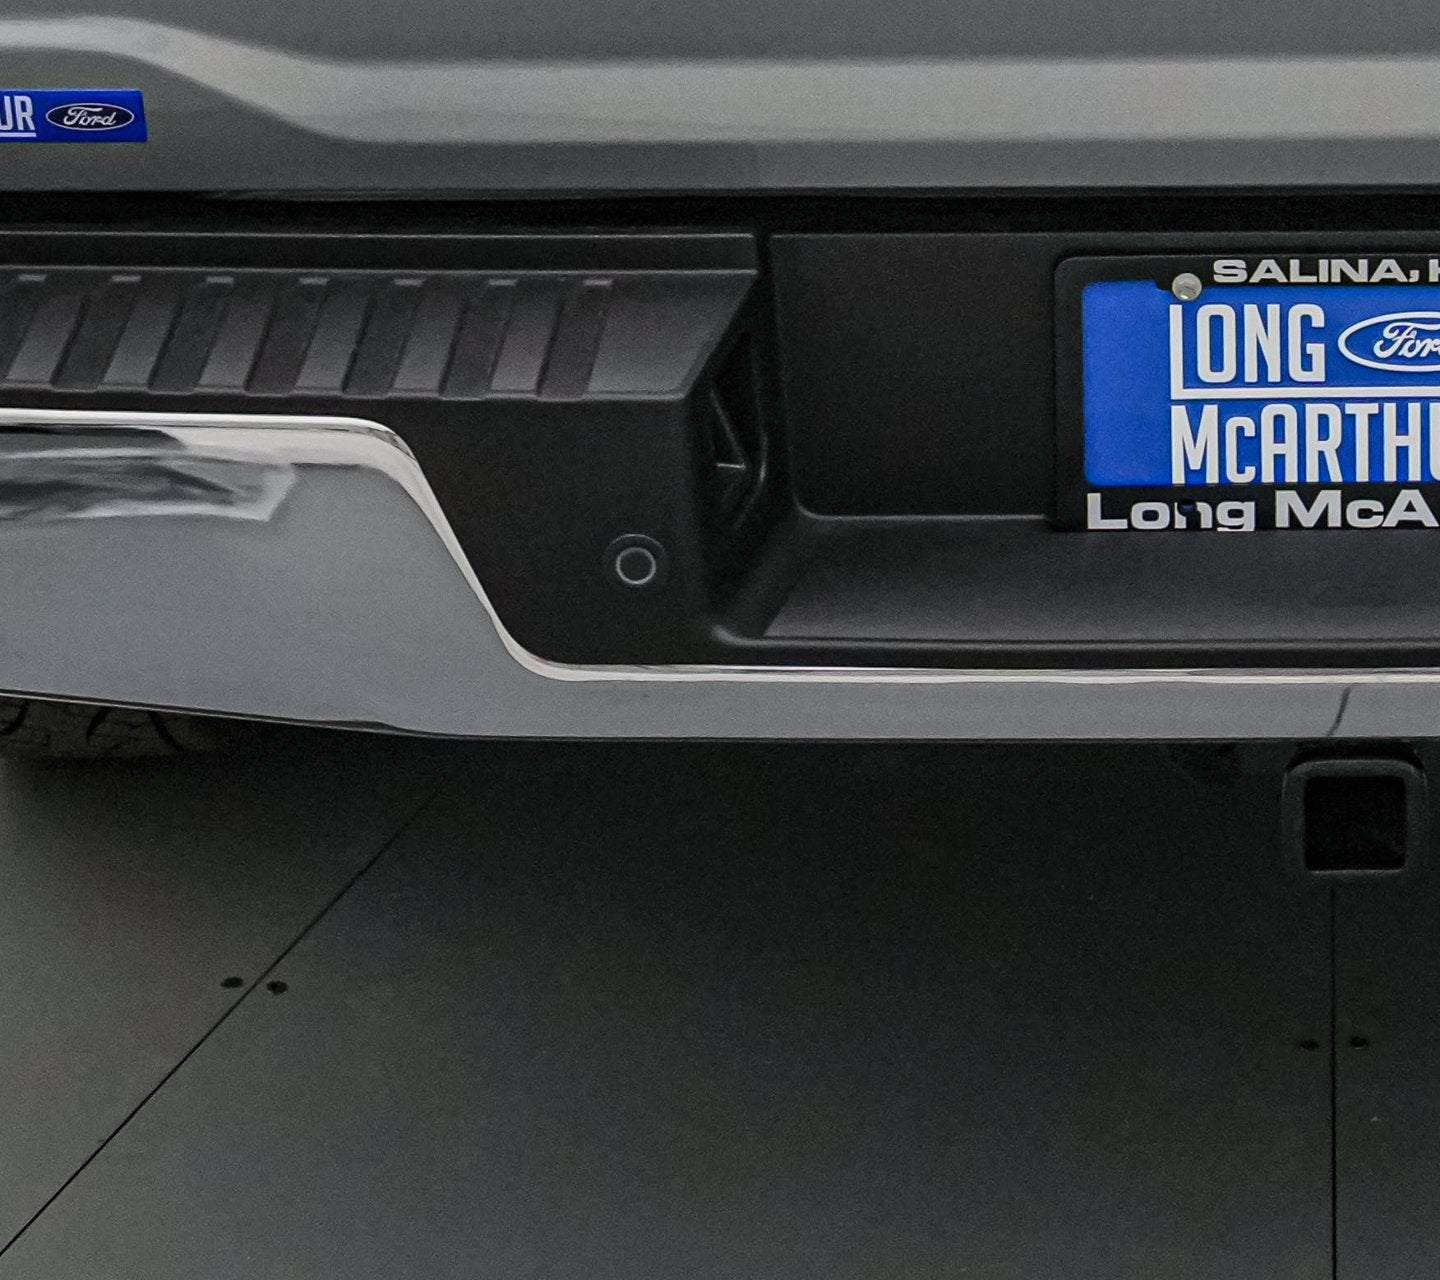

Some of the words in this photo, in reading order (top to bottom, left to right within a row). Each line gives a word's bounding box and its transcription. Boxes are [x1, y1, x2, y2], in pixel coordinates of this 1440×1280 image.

[63, 106, 118, 127] Ford
[1169, 302, 1326, 399] LONG
[1086, 491, 1256, 532] Long
